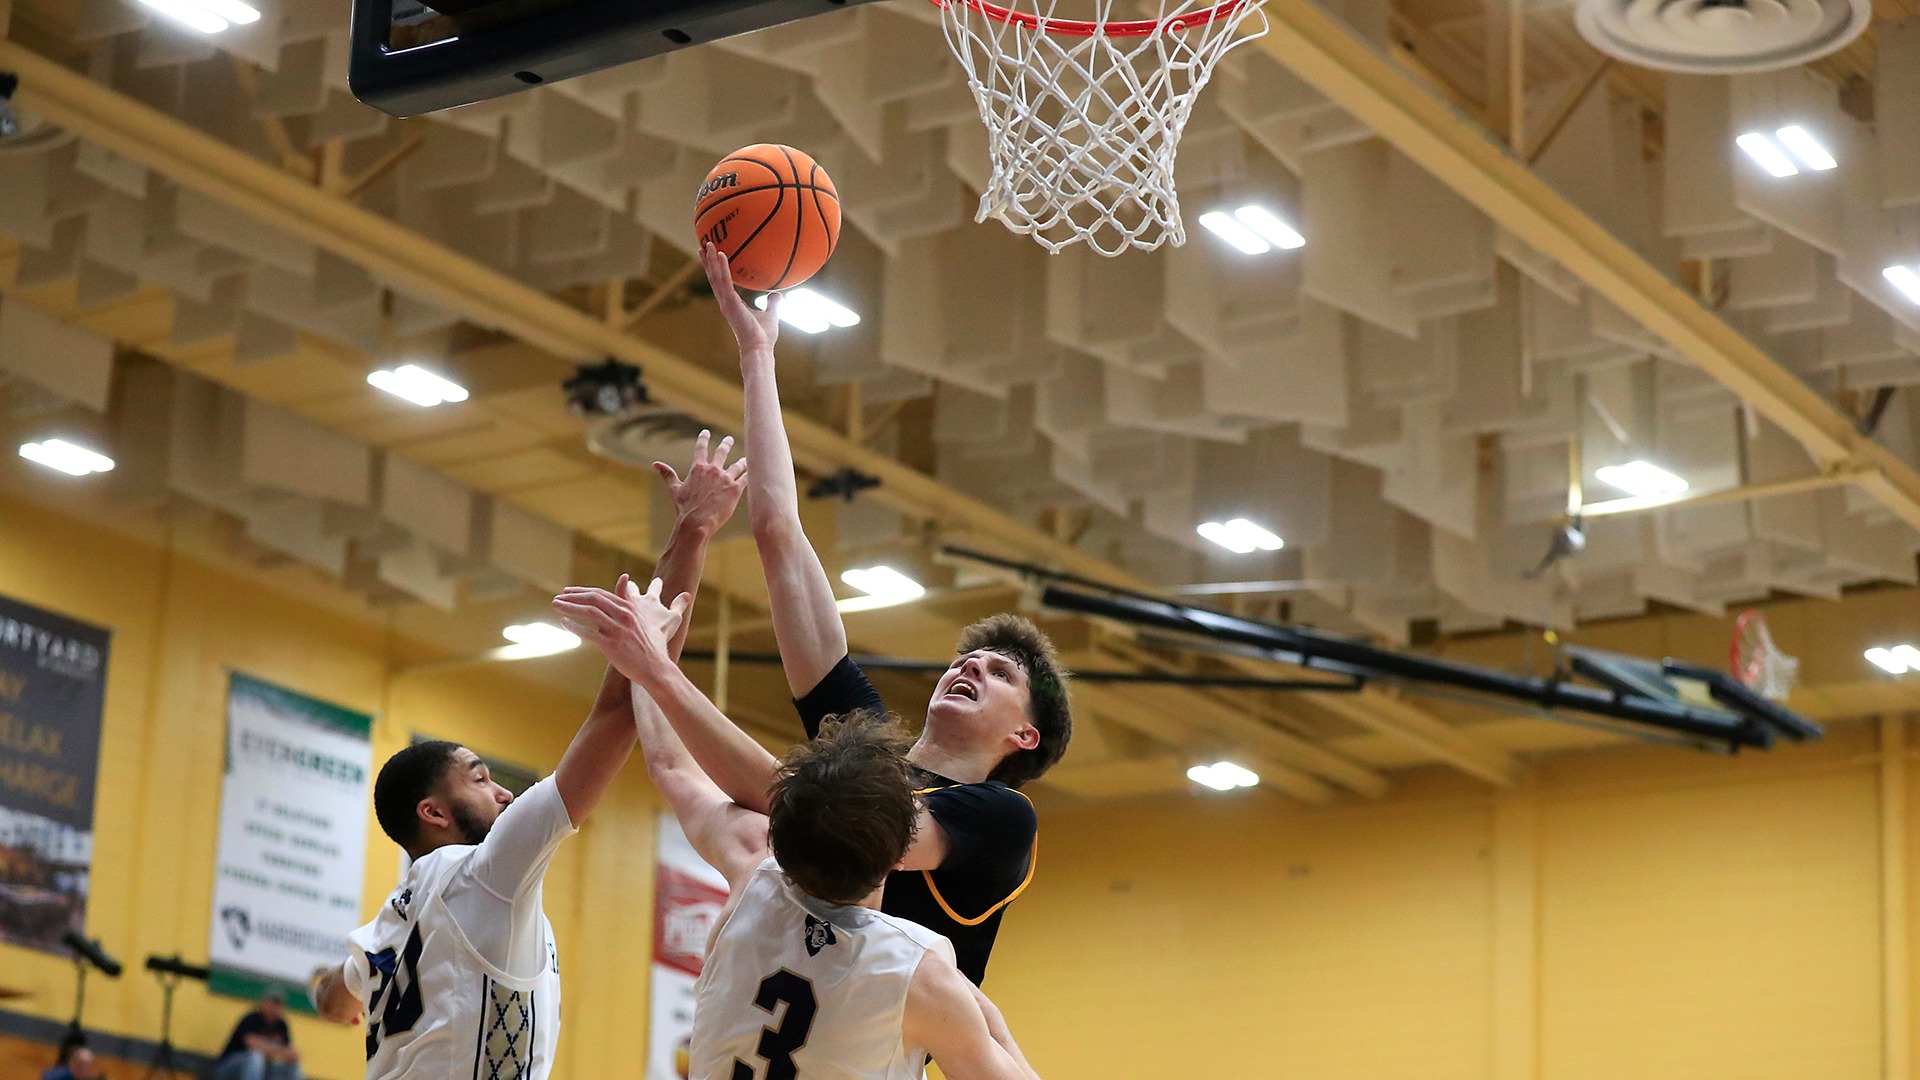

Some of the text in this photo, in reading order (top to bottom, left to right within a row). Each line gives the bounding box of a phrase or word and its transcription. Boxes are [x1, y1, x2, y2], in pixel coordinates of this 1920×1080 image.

[0, 618, 99, 671] RTYARD
[241, 728, 364, 783] EVERGREEN
[730, 967, 819, 1080] 3
